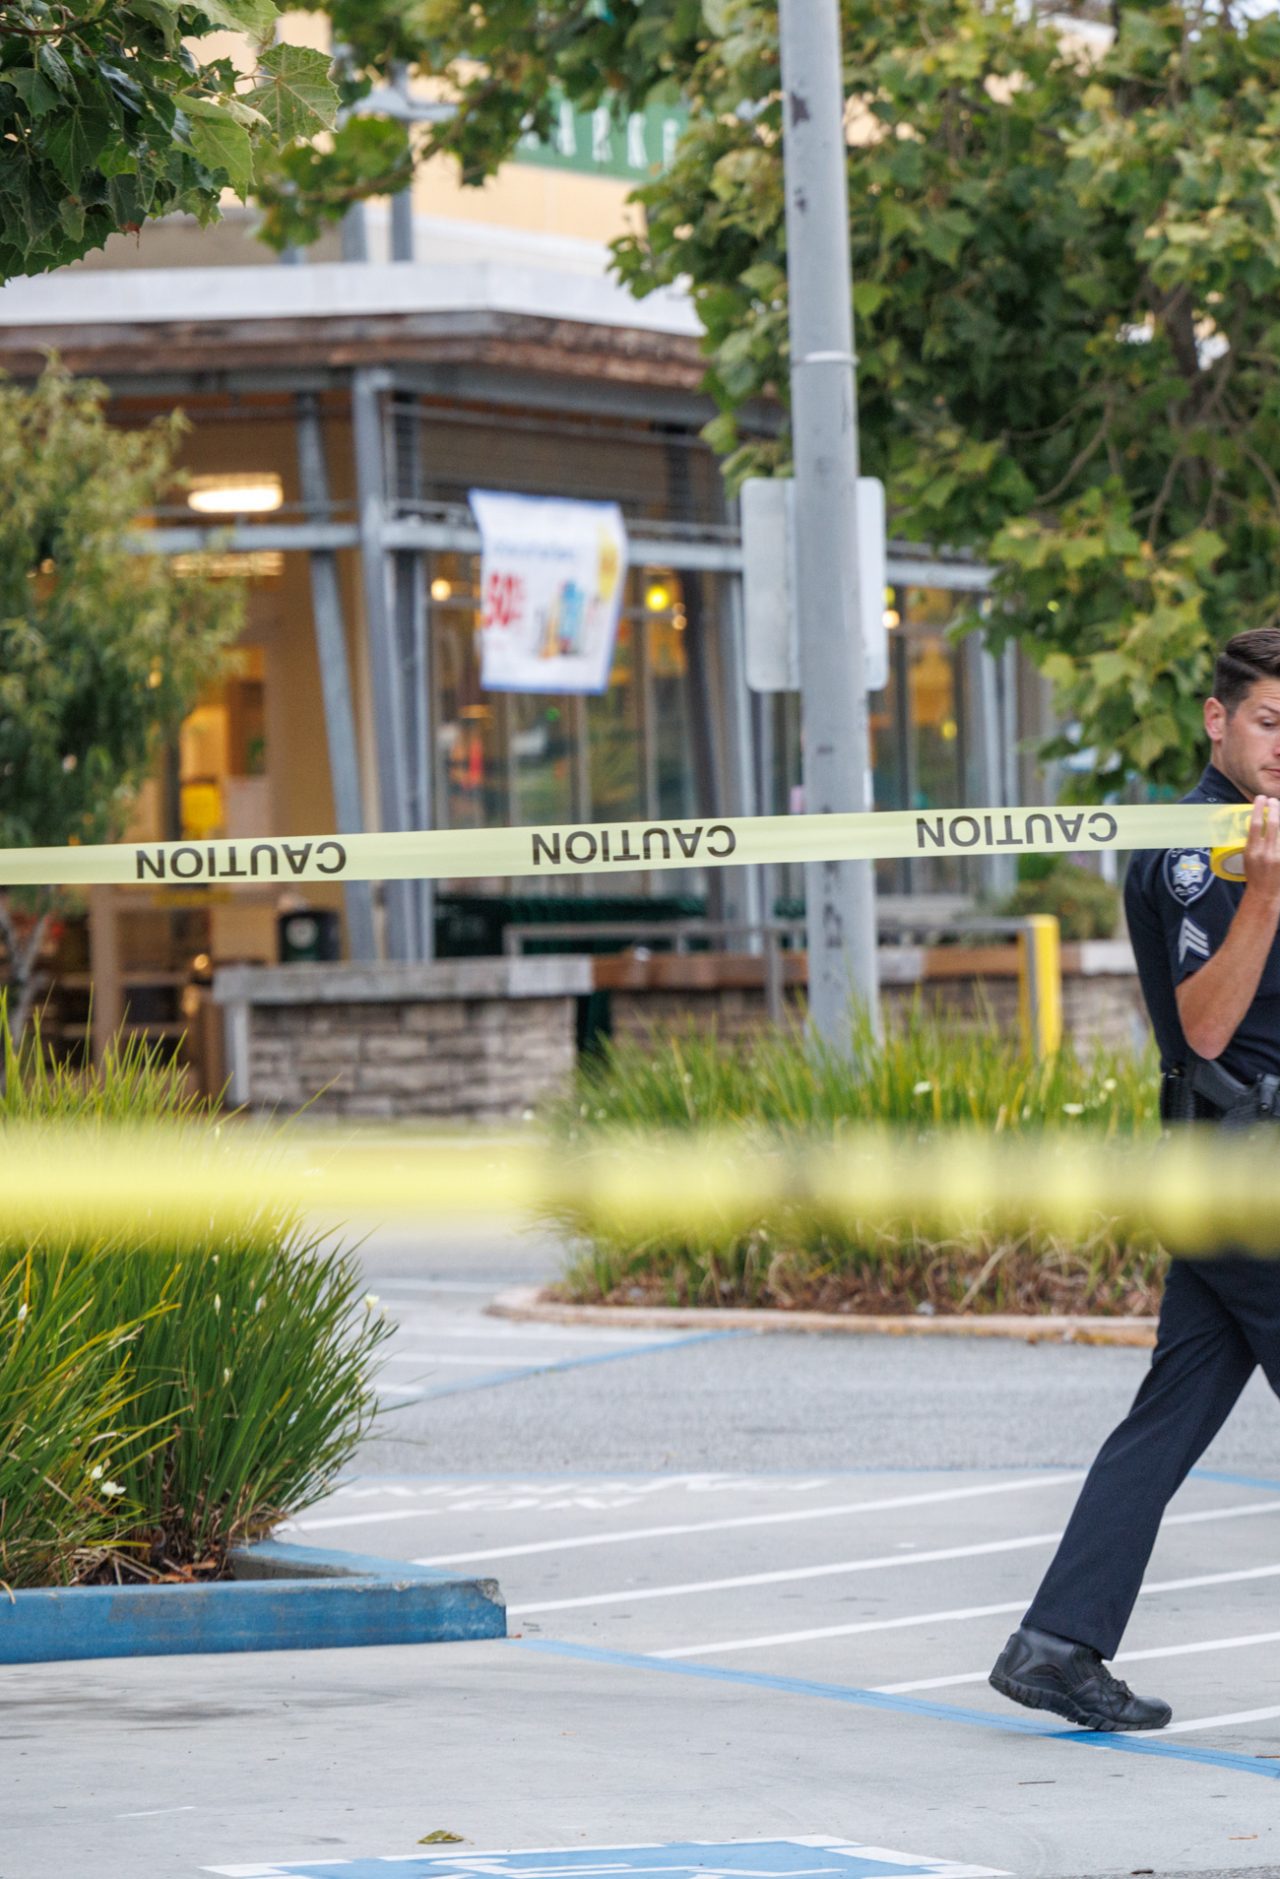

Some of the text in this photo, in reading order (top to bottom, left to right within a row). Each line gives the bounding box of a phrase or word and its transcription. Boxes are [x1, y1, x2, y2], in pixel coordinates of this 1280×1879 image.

[136, 811, 1118, 879] CAUTION CAUTION CAUTION
